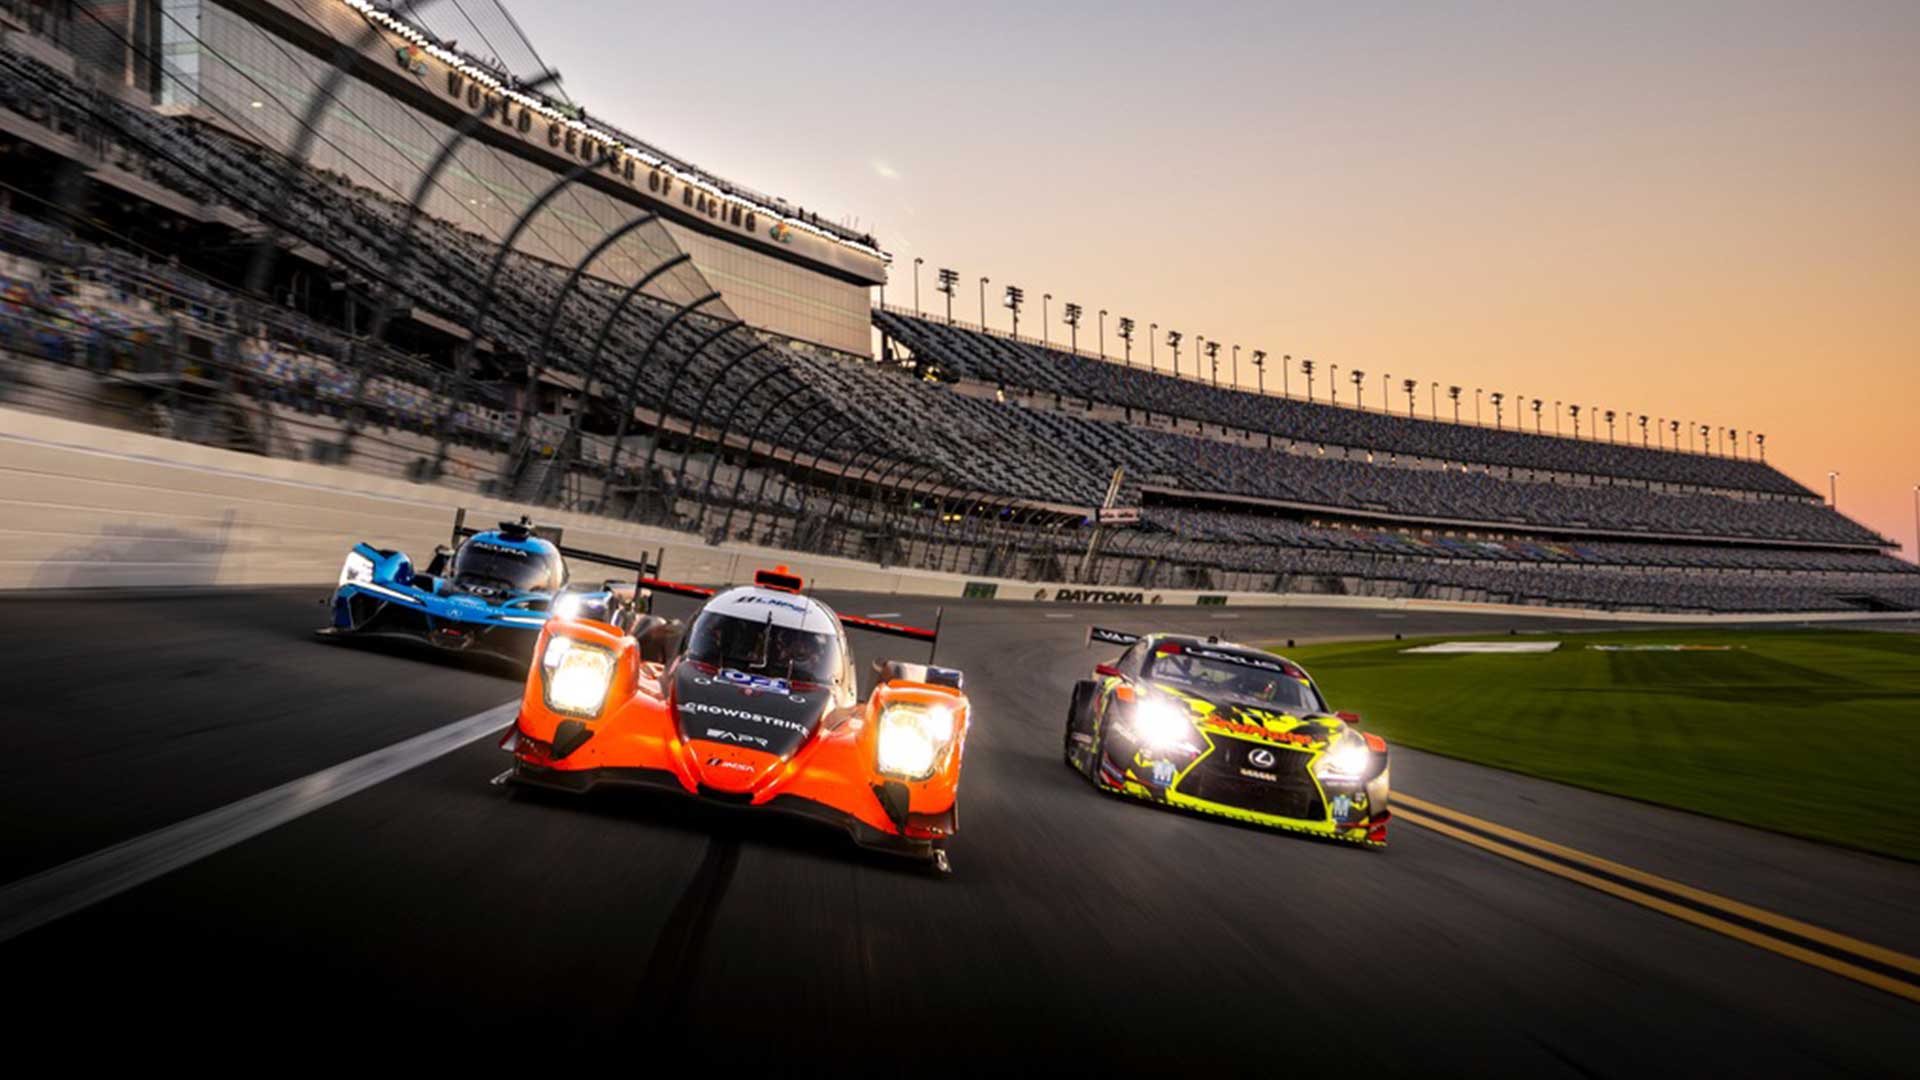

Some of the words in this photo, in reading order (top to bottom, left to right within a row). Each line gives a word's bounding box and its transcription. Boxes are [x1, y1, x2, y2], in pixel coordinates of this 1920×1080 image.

[448, 71, 532, 133] WORLD
[548, 123, 636, 181] CENTER
[648, 170, 671, 197] OF
[683, 186, 757, 233] RACING
[473, 542, 528, 557] ACURA
[1055, 589, 1144, 604] DAYTONA
[1184, 647, 1281, 672] LEXUS
[685, 702, 809, 738] CROWDSTRIKE
